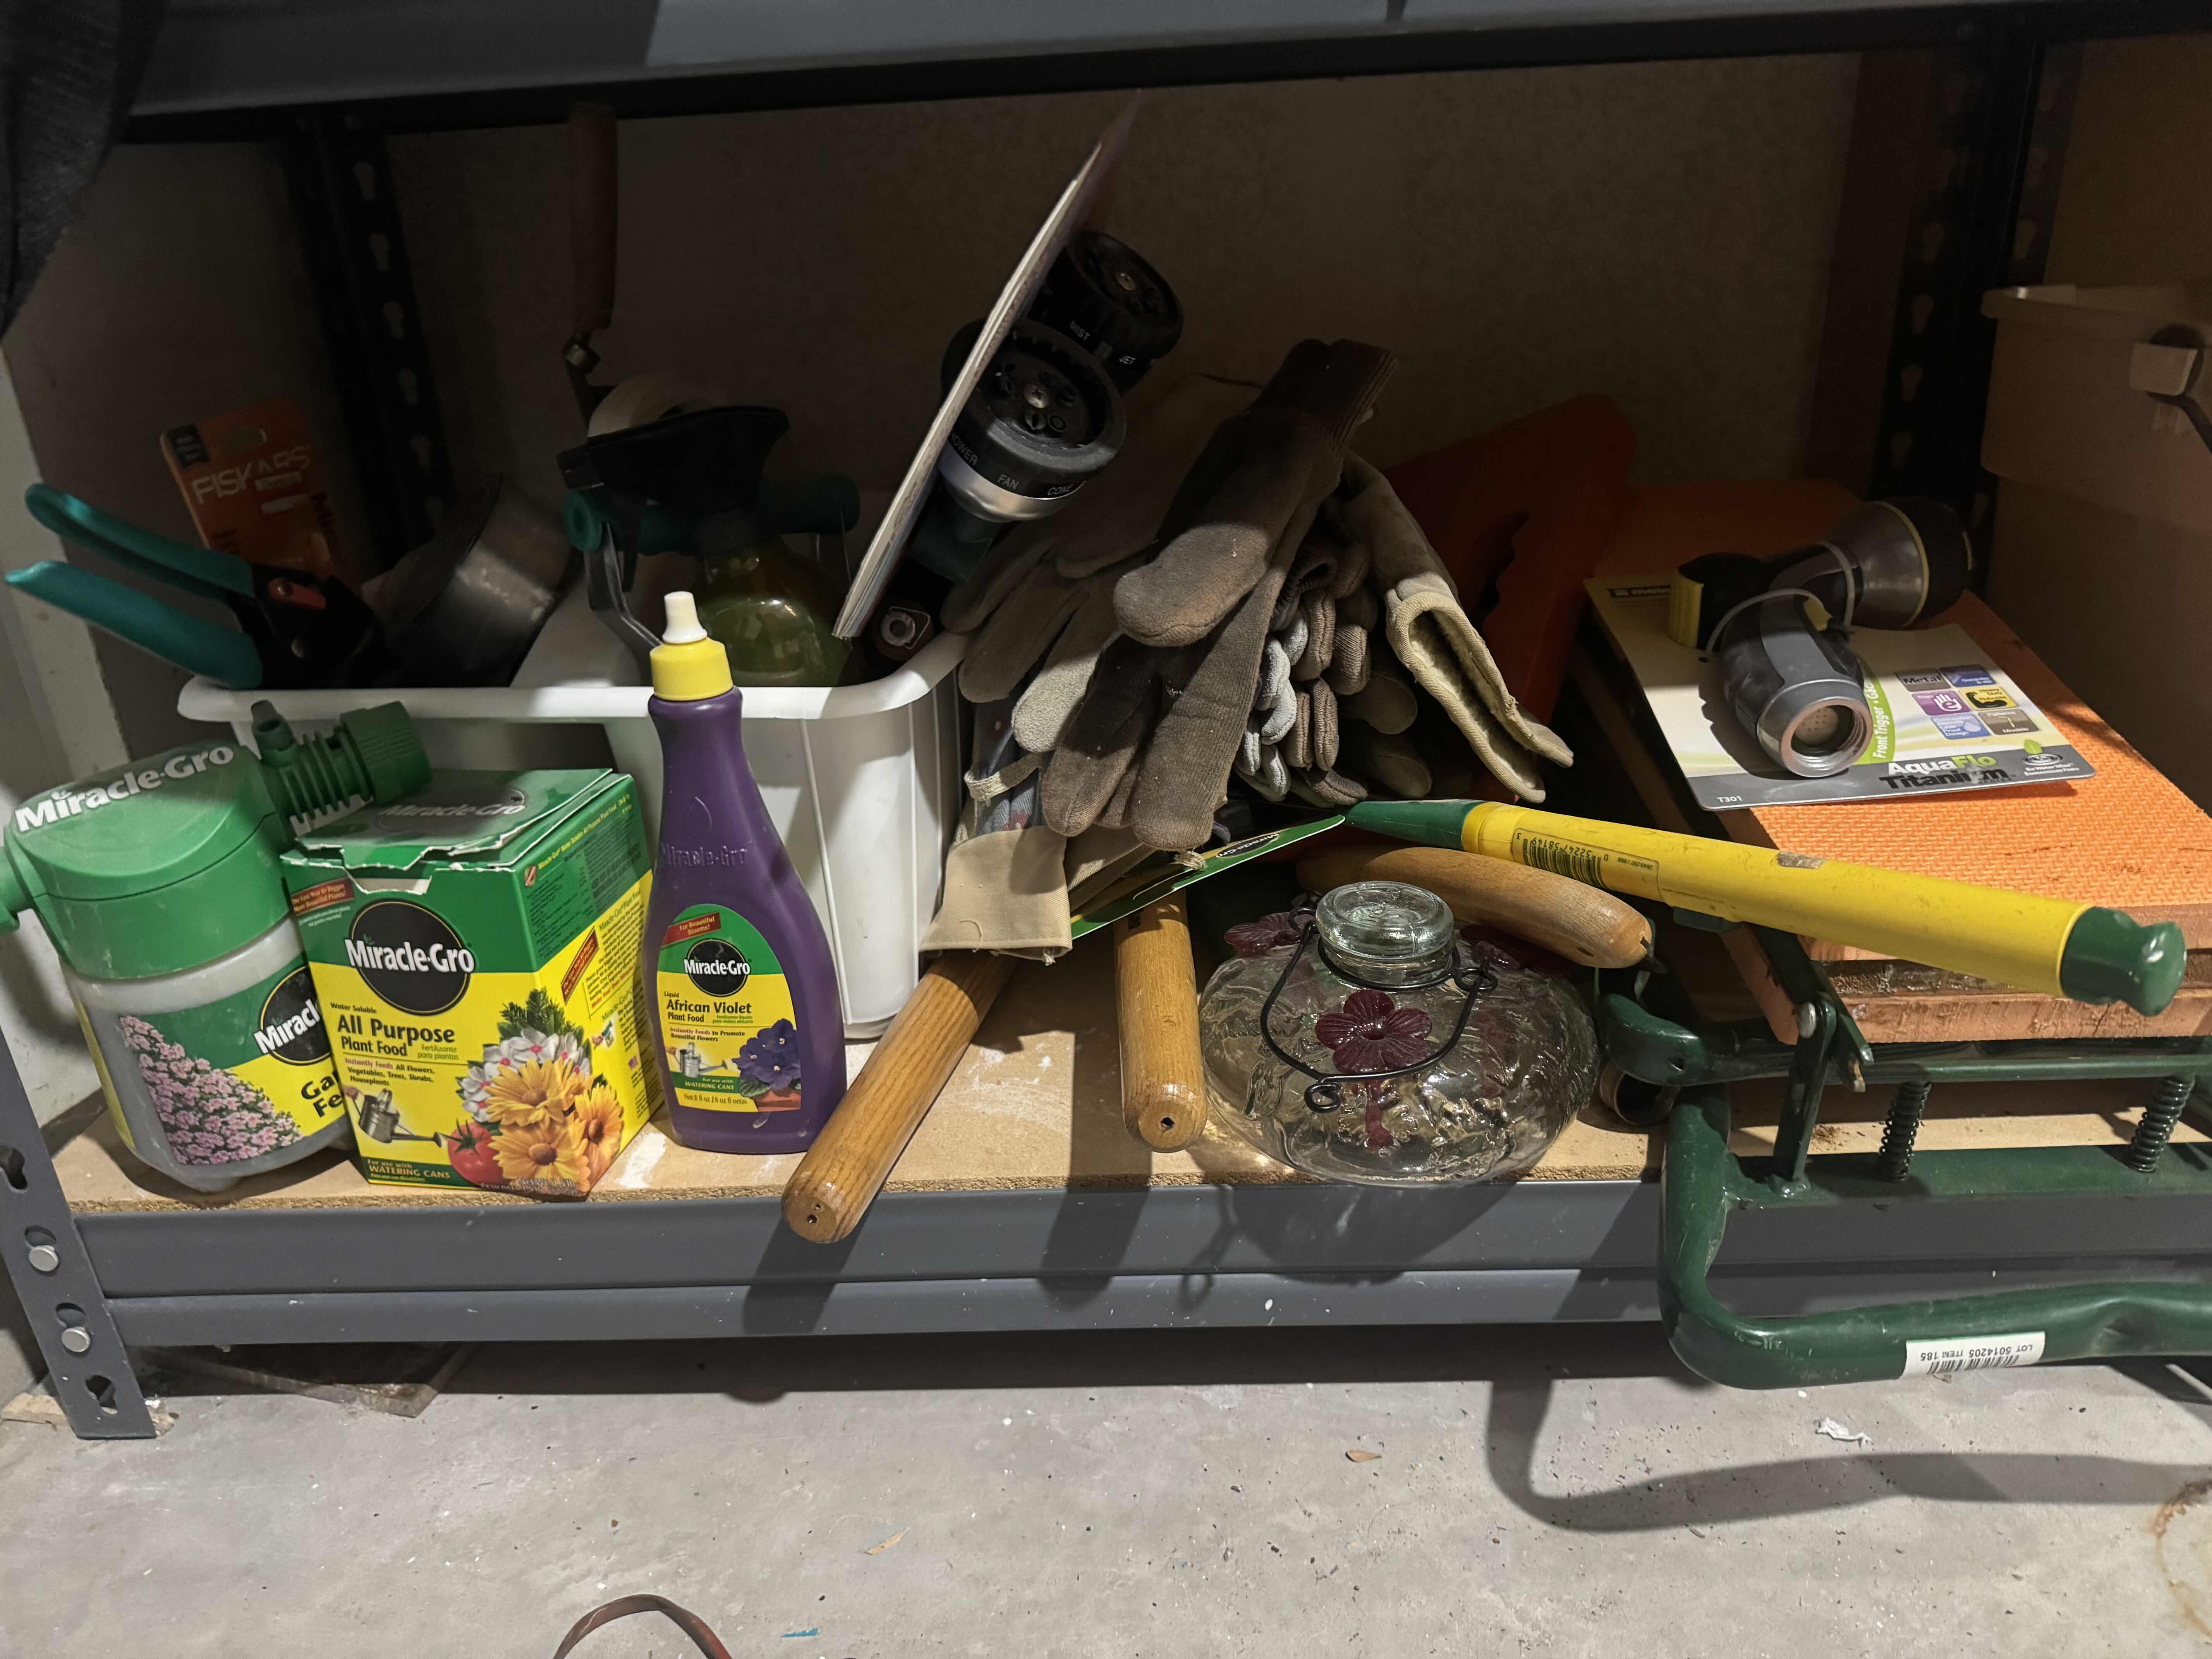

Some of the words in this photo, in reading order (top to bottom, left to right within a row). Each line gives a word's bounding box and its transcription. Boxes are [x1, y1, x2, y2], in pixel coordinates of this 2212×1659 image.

[997, 474, 1020, 490] FAN
[1047, 484, 1074, 496] CONE
[1873, 706, 1891, 735] Trigger
[1872, 736, 1888, 758] Front
[1888, 755, 1996, 775] AquaFlo
[15, 745, 234, 833] Miracle-Gro
[689, 916, 715, 927] Beautiful
[687, 924, 710, 935] Blooms!
[345, 938, 475, 974] Miracle-Gro
[684, 958, 750, 975] Miracle-Gro
[330, 1002, 351, 1012] Water
[353, 1005, 377, 1014] Soluble
[667, 999, 710, 1013] African
[713, 1002, 752, 1014] Violet
[668, 1012, 685, 1021] Plant
[688, 1014, 704, 1022] Food
[337, 1014, 363, 1035] All
[371, 1018, 455, 1046] Purpose
[671, 1032, 696, 1041] Beautiful
[341, 1036, 374, 1053] Plant
[377, 1040, 408, 1056] Food
[434, 1051, 459, 1060] plantas
[344, 1058, 374, 1068] Instantly
[375, 1061, 393, 1069] Feeds
[407, 1065, 435, 1074] Flowers,
[348, 1066, 385, 1078] Vegetables,
[388, 1071, 407, 1080] Trees,
[409, 1073, 434, 1082] Shrubs,
[350, 1075, 390, 1086] Houseplants
[685, 1081, 716, 1089] WATERING
[369, 1165, 421, 1176] WATERING
[424, 1170, 450, 1178] CANS
[1942, 1350, 1963, 1358] ITEM
[2015, 1344, 2033, 1353] LOT
[1920, 1352, 1937, 1361] 185
